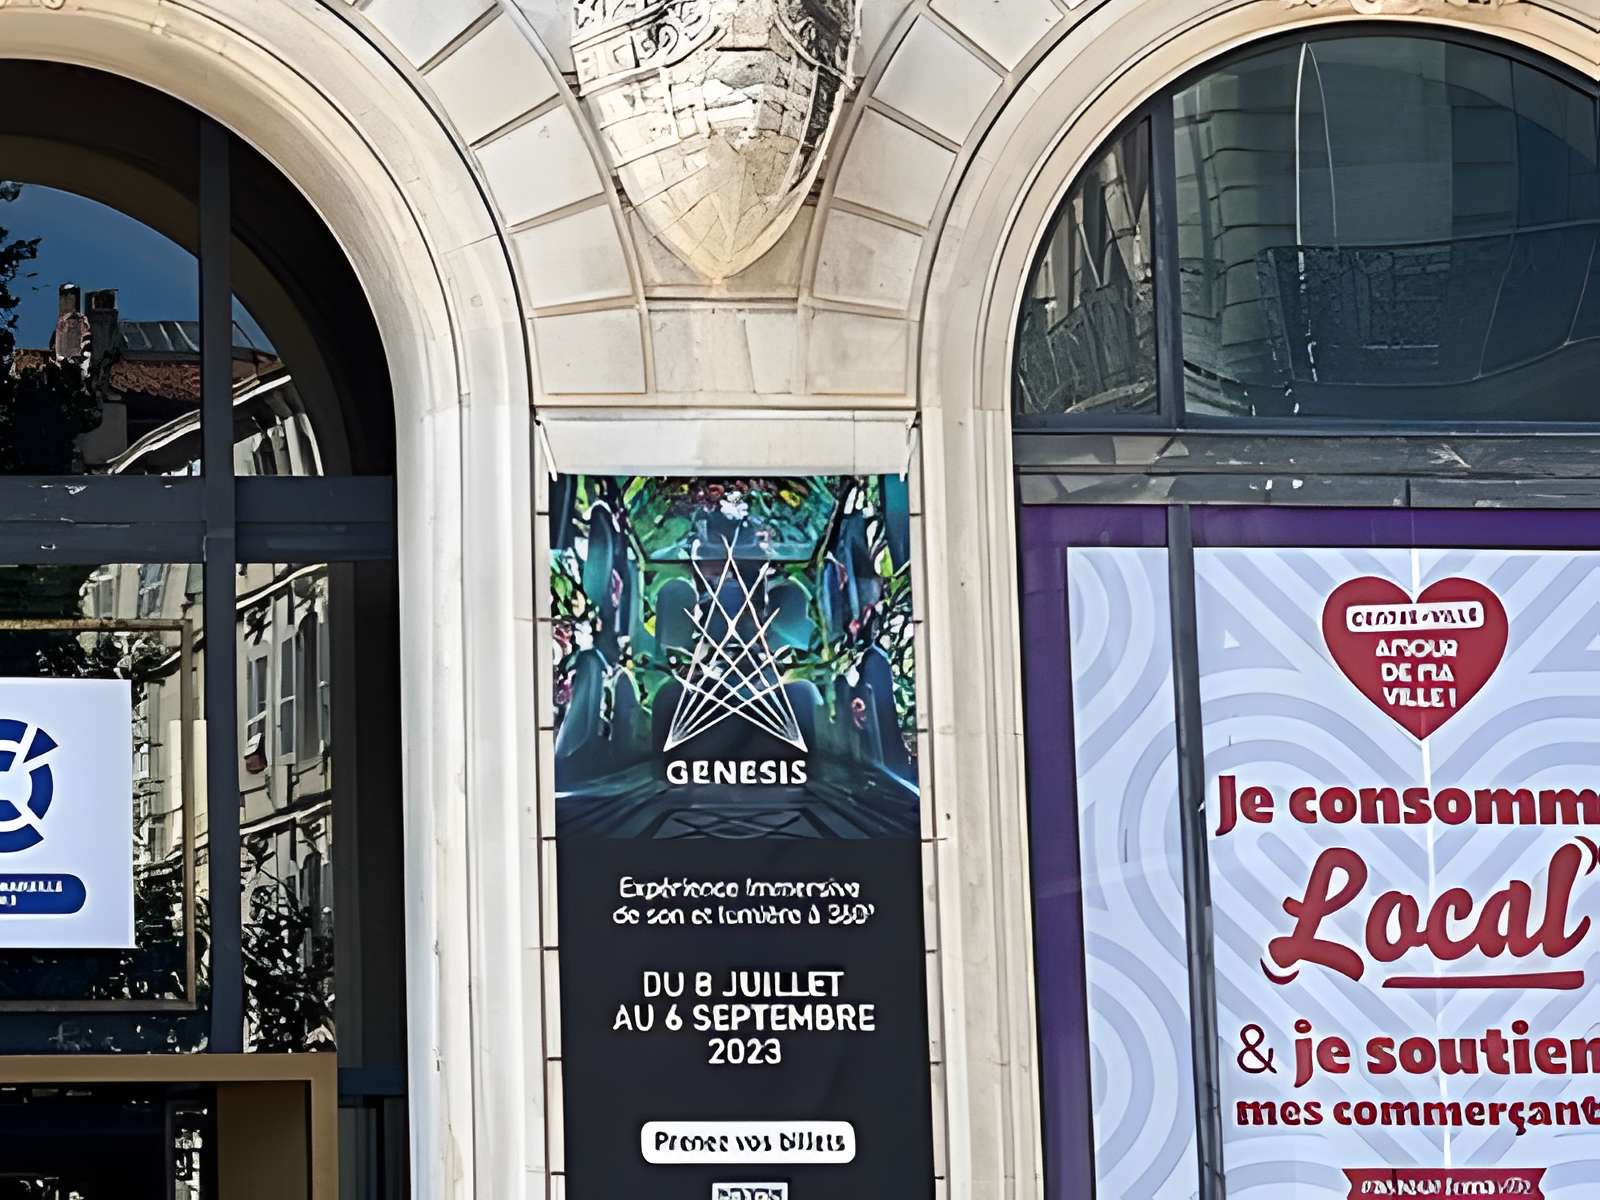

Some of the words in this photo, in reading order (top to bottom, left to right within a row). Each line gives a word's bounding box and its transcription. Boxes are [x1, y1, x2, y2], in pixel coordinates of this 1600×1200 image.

[1381, 663, 1412, 682] DE
[666, 759, 808, 785] GENESIS
[1216, 775, 1274, 835] Je
[1289, 786, 1600, 825] consomm
[1267, 841, 1592, 984] Local
[643, 971, 685, 998] DU
[695, 971, 712, 998] 8
[722, 970, 845, 998] JUILLET
[612, 1003, 655, 1032] AU
[665, 1003, 684, 1031] 6
[693, 1003, 876, 1032] SEPTEMBRE
[708, 1037, 782, 1064] 2023
[1237, 1024, 1276, 1075] &
[1295, 1019, 1351, 1088] je
[1366, 1019, 1600, 1075] soutien
[1236, 1099, 1324, 1127] mes
